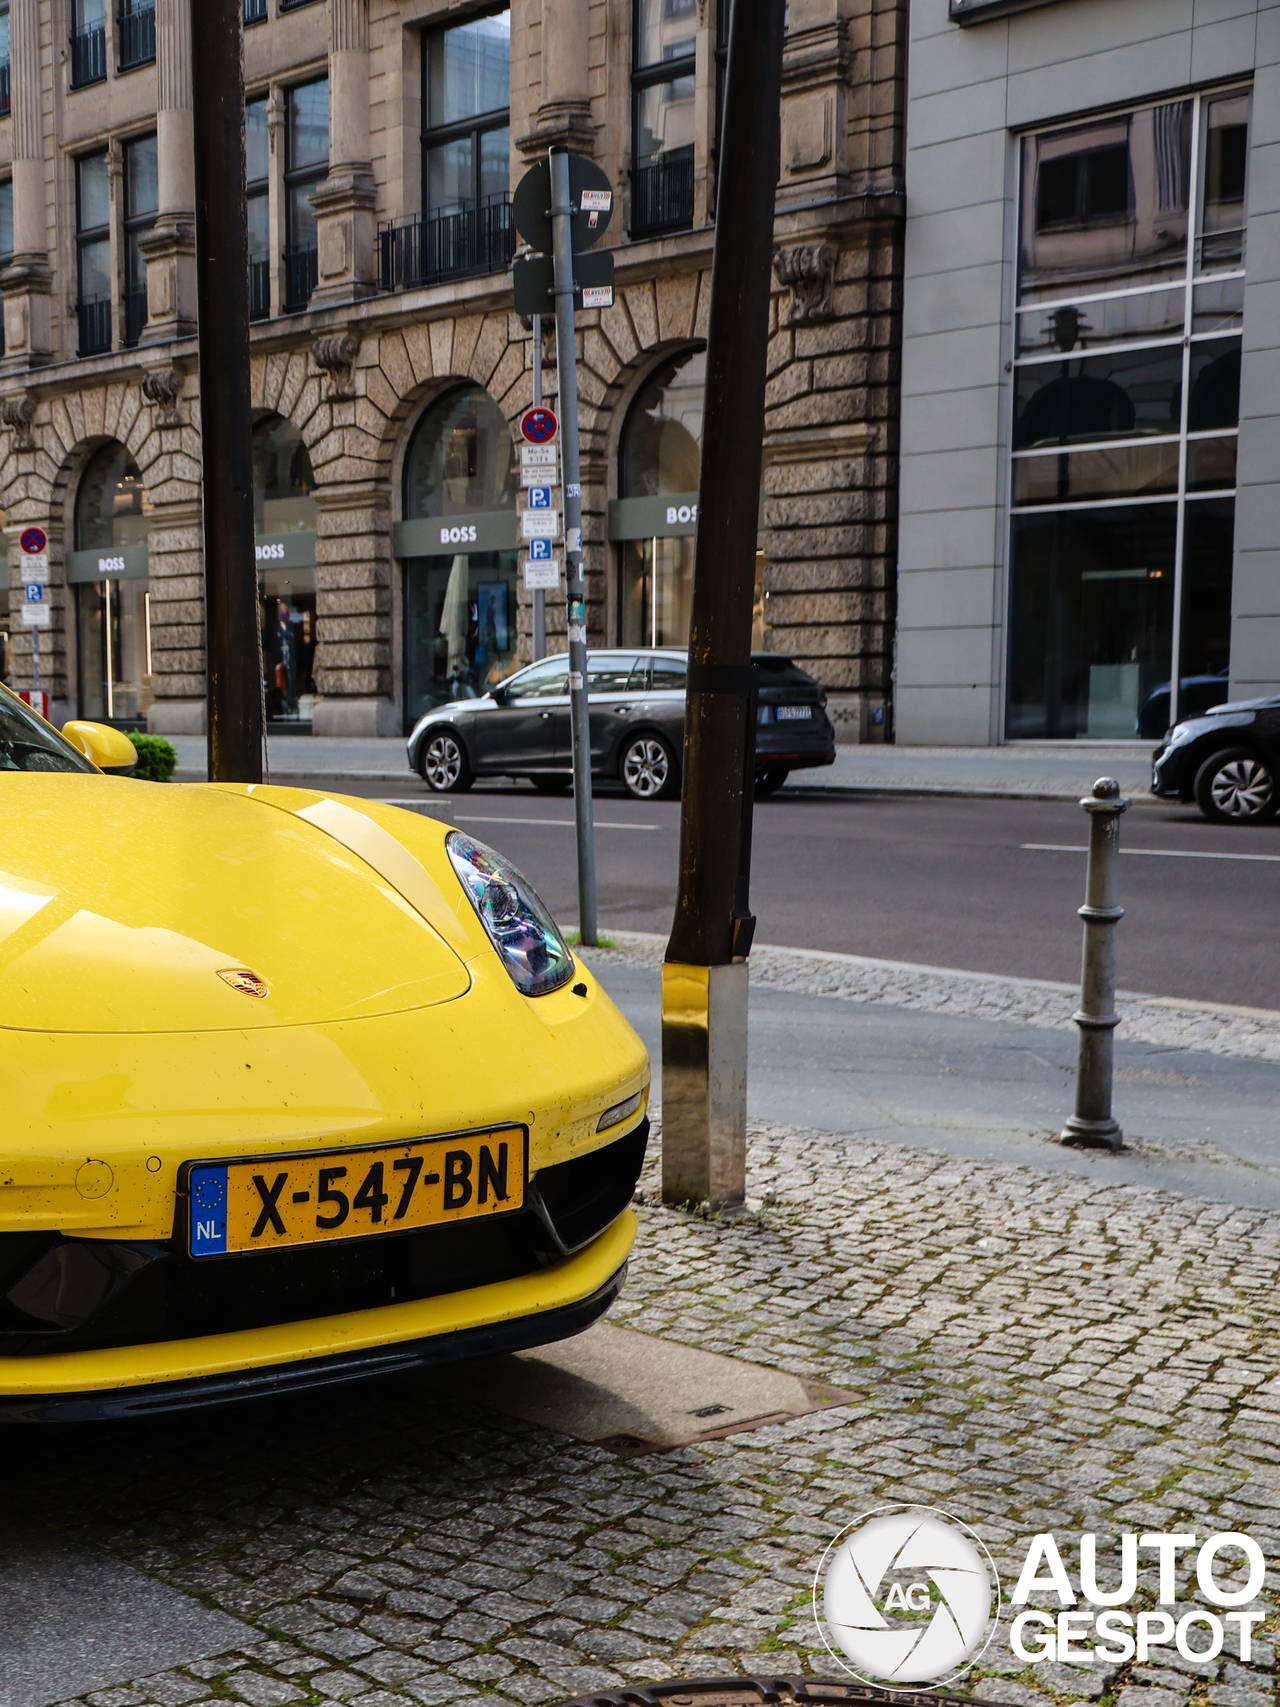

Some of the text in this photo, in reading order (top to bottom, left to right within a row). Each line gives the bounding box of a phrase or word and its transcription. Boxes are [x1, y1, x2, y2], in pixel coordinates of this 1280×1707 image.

[666, 504, 698, 524] BOS
[440, 526, 478, 544] BOSS
[98, 557, 126, 572] BOSS
[250, 1142, 509, 1238] X-547-BN
[196, 1220, 222, 1241] NL
